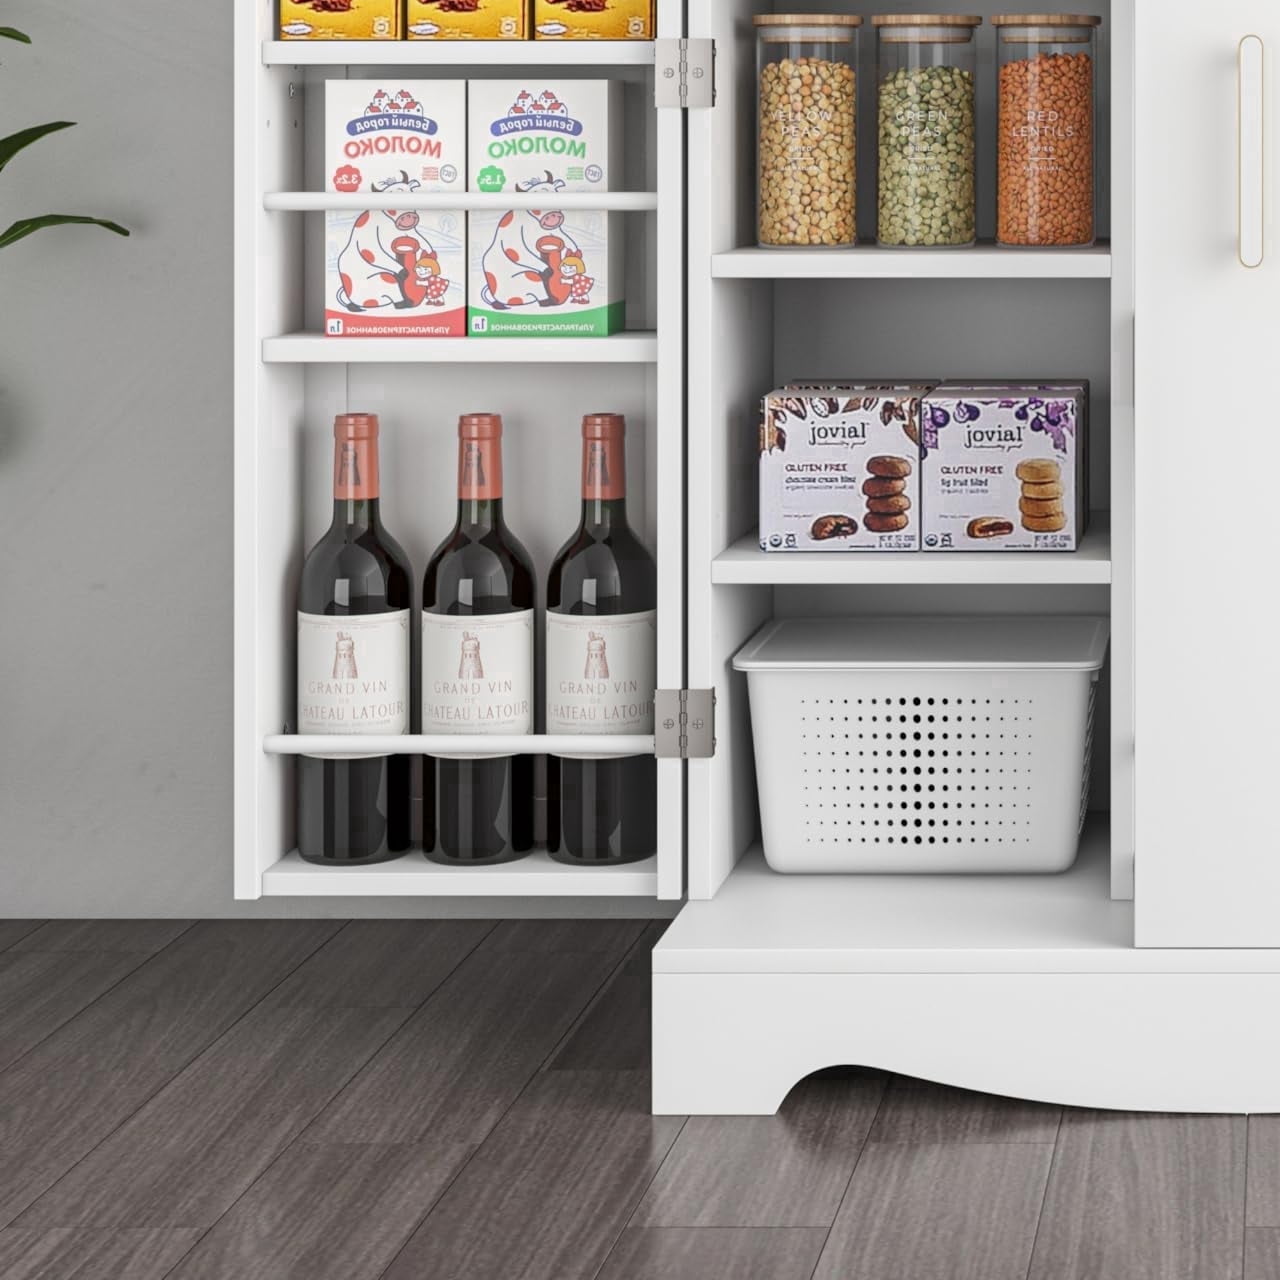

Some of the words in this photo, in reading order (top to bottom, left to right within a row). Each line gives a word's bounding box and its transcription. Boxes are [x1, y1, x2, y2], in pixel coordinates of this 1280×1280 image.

[896, 110, 948, 121] GREEN
[1027, 110, 1059, 121] RED
[782, 126, 820, 136] PEAS
[902, 126, 941, 136] PEAS
[1012, 126, 1074, 137] LENTILS
[809, 421, 866, 445] jovial
[964, 424, 1023, 448] jovial
[308, 681, 355, 695] GRAND
[362, 680, 387, 694] VIN
[434, 681, 480, 695] GRAND
[488, 680, 512, 694] VIN
[560, 681, 606, 695] GRAND
[615, 680, 637, 694] VIN
